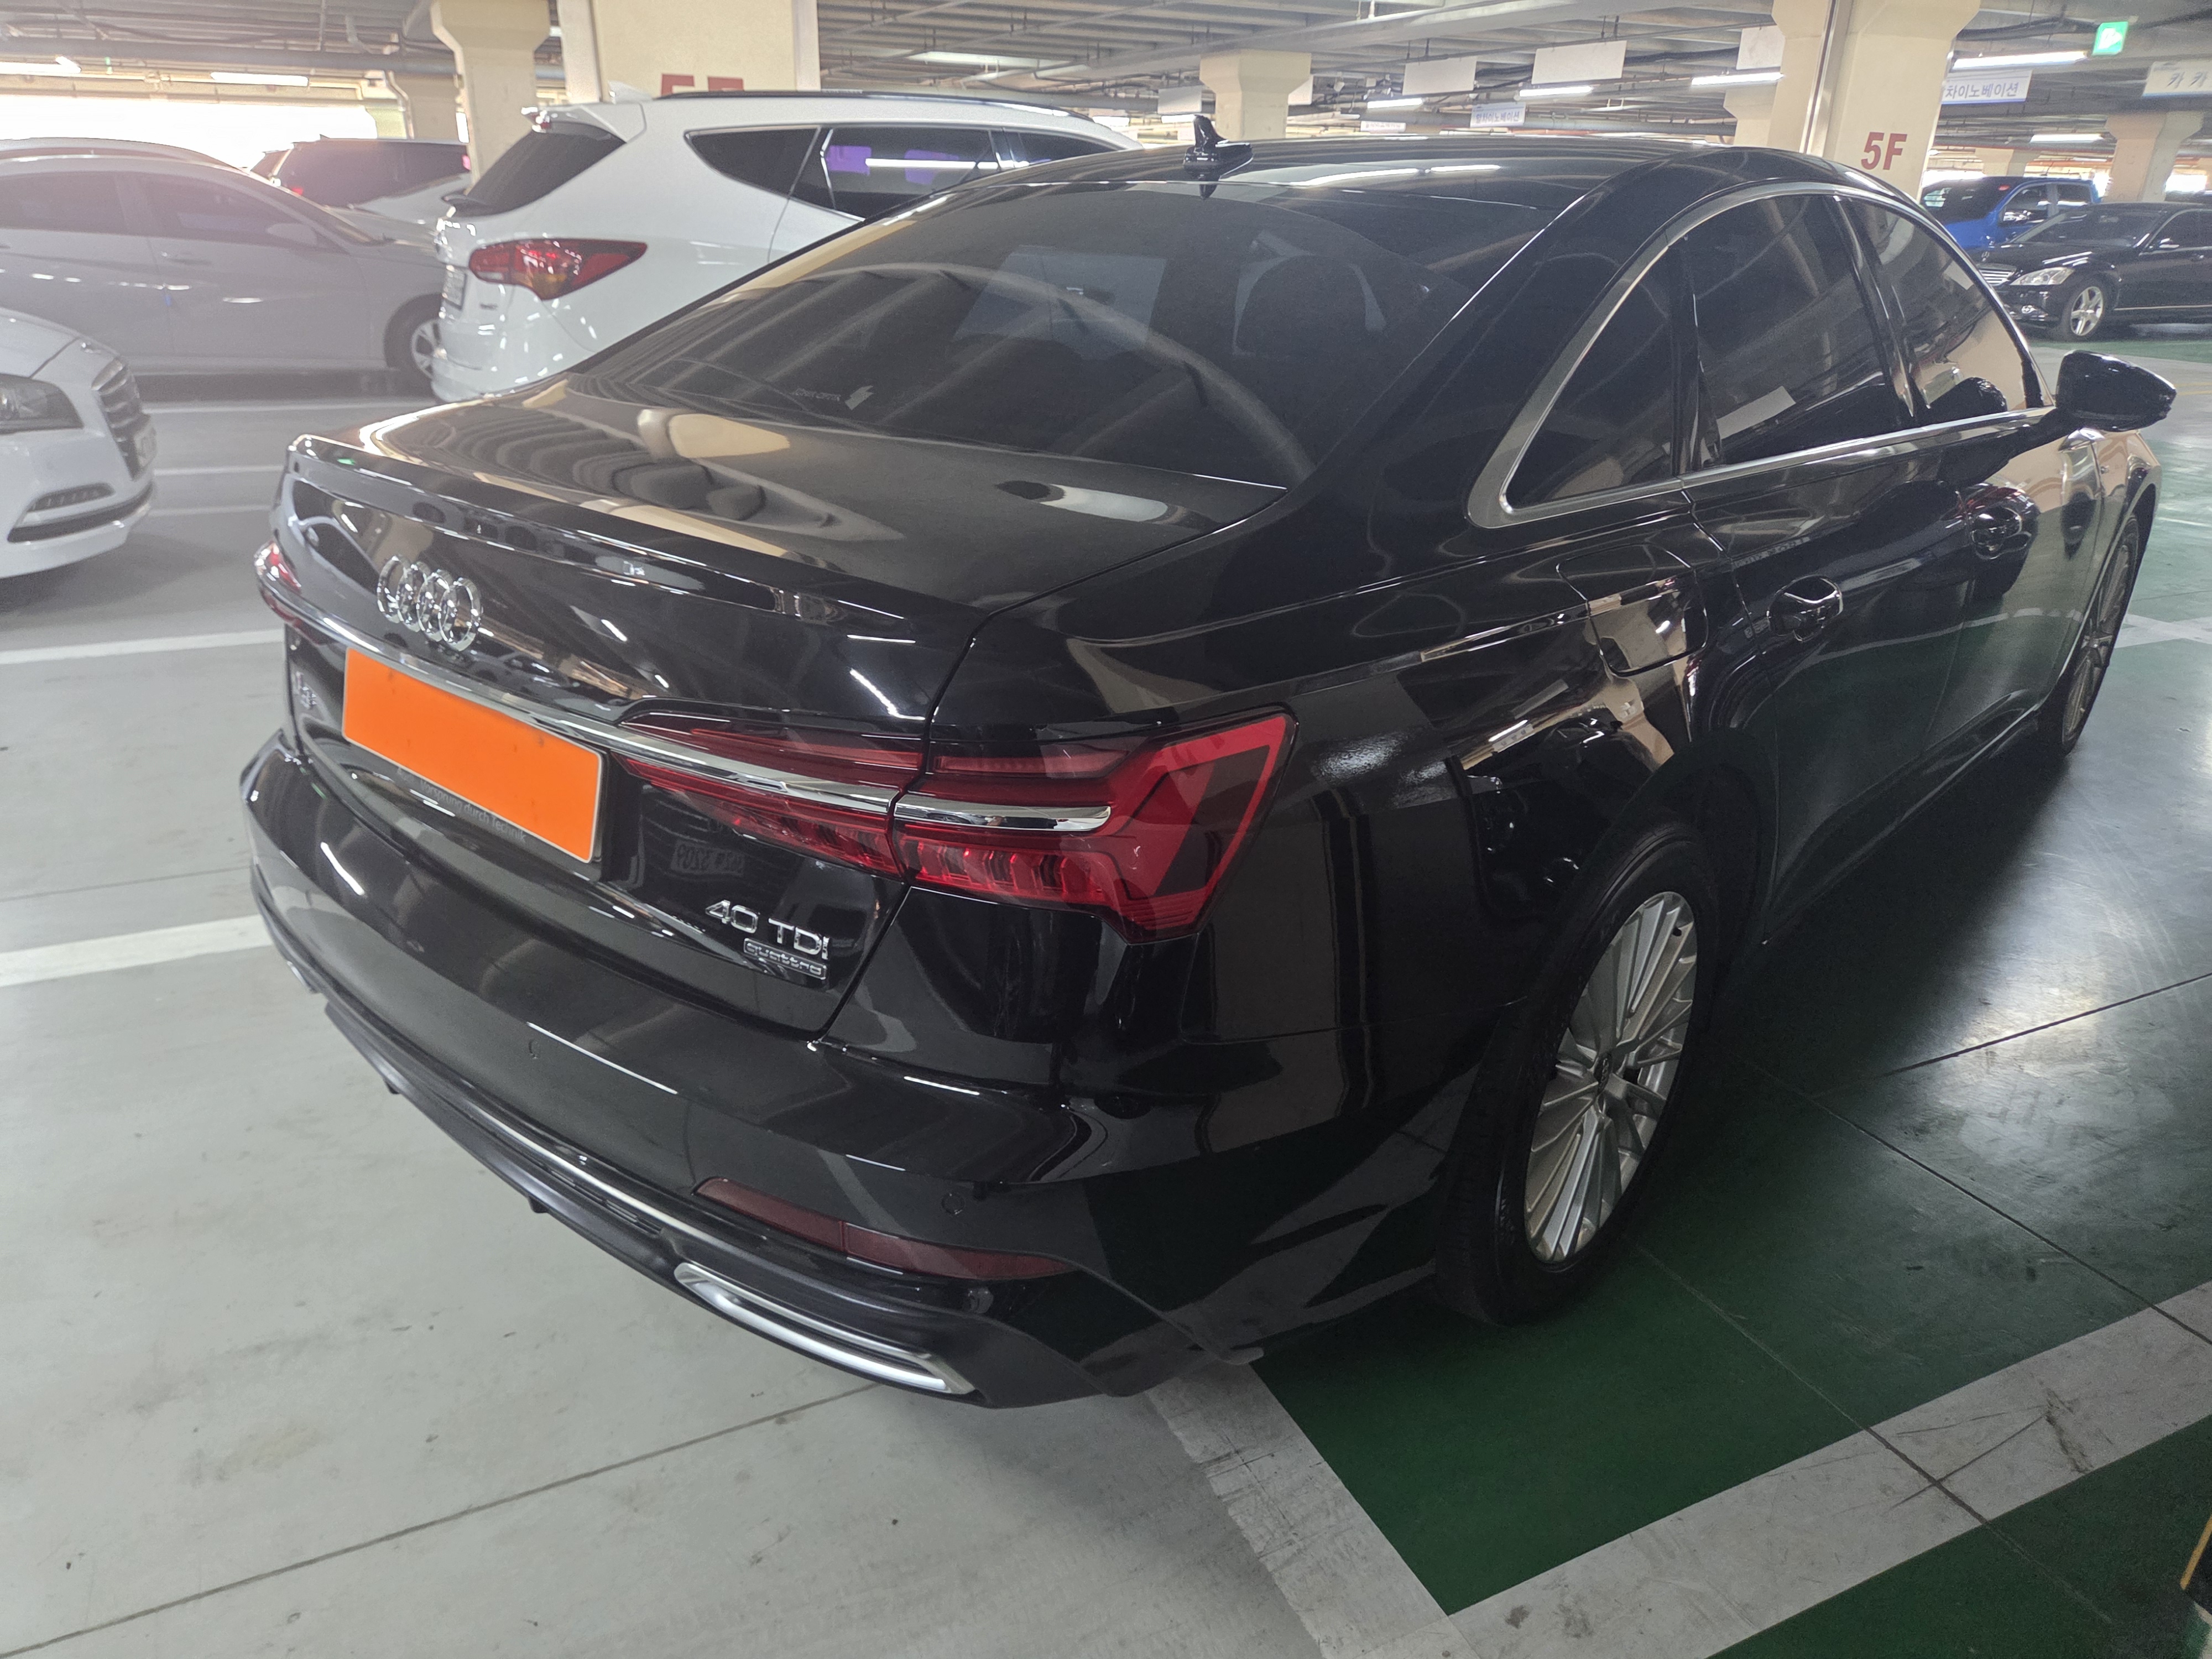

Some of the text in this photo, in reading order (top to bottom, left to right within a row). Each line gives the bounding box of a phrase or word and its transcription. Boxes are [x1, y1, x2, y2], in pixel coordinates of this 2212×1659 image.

[1943, 82, 2019, 99] 차이노베이션
[1861, 132, 1907, 170] 5F
[705, 900, 830, 960] 40 TDI
[747, 942, 822, 975] quattro
